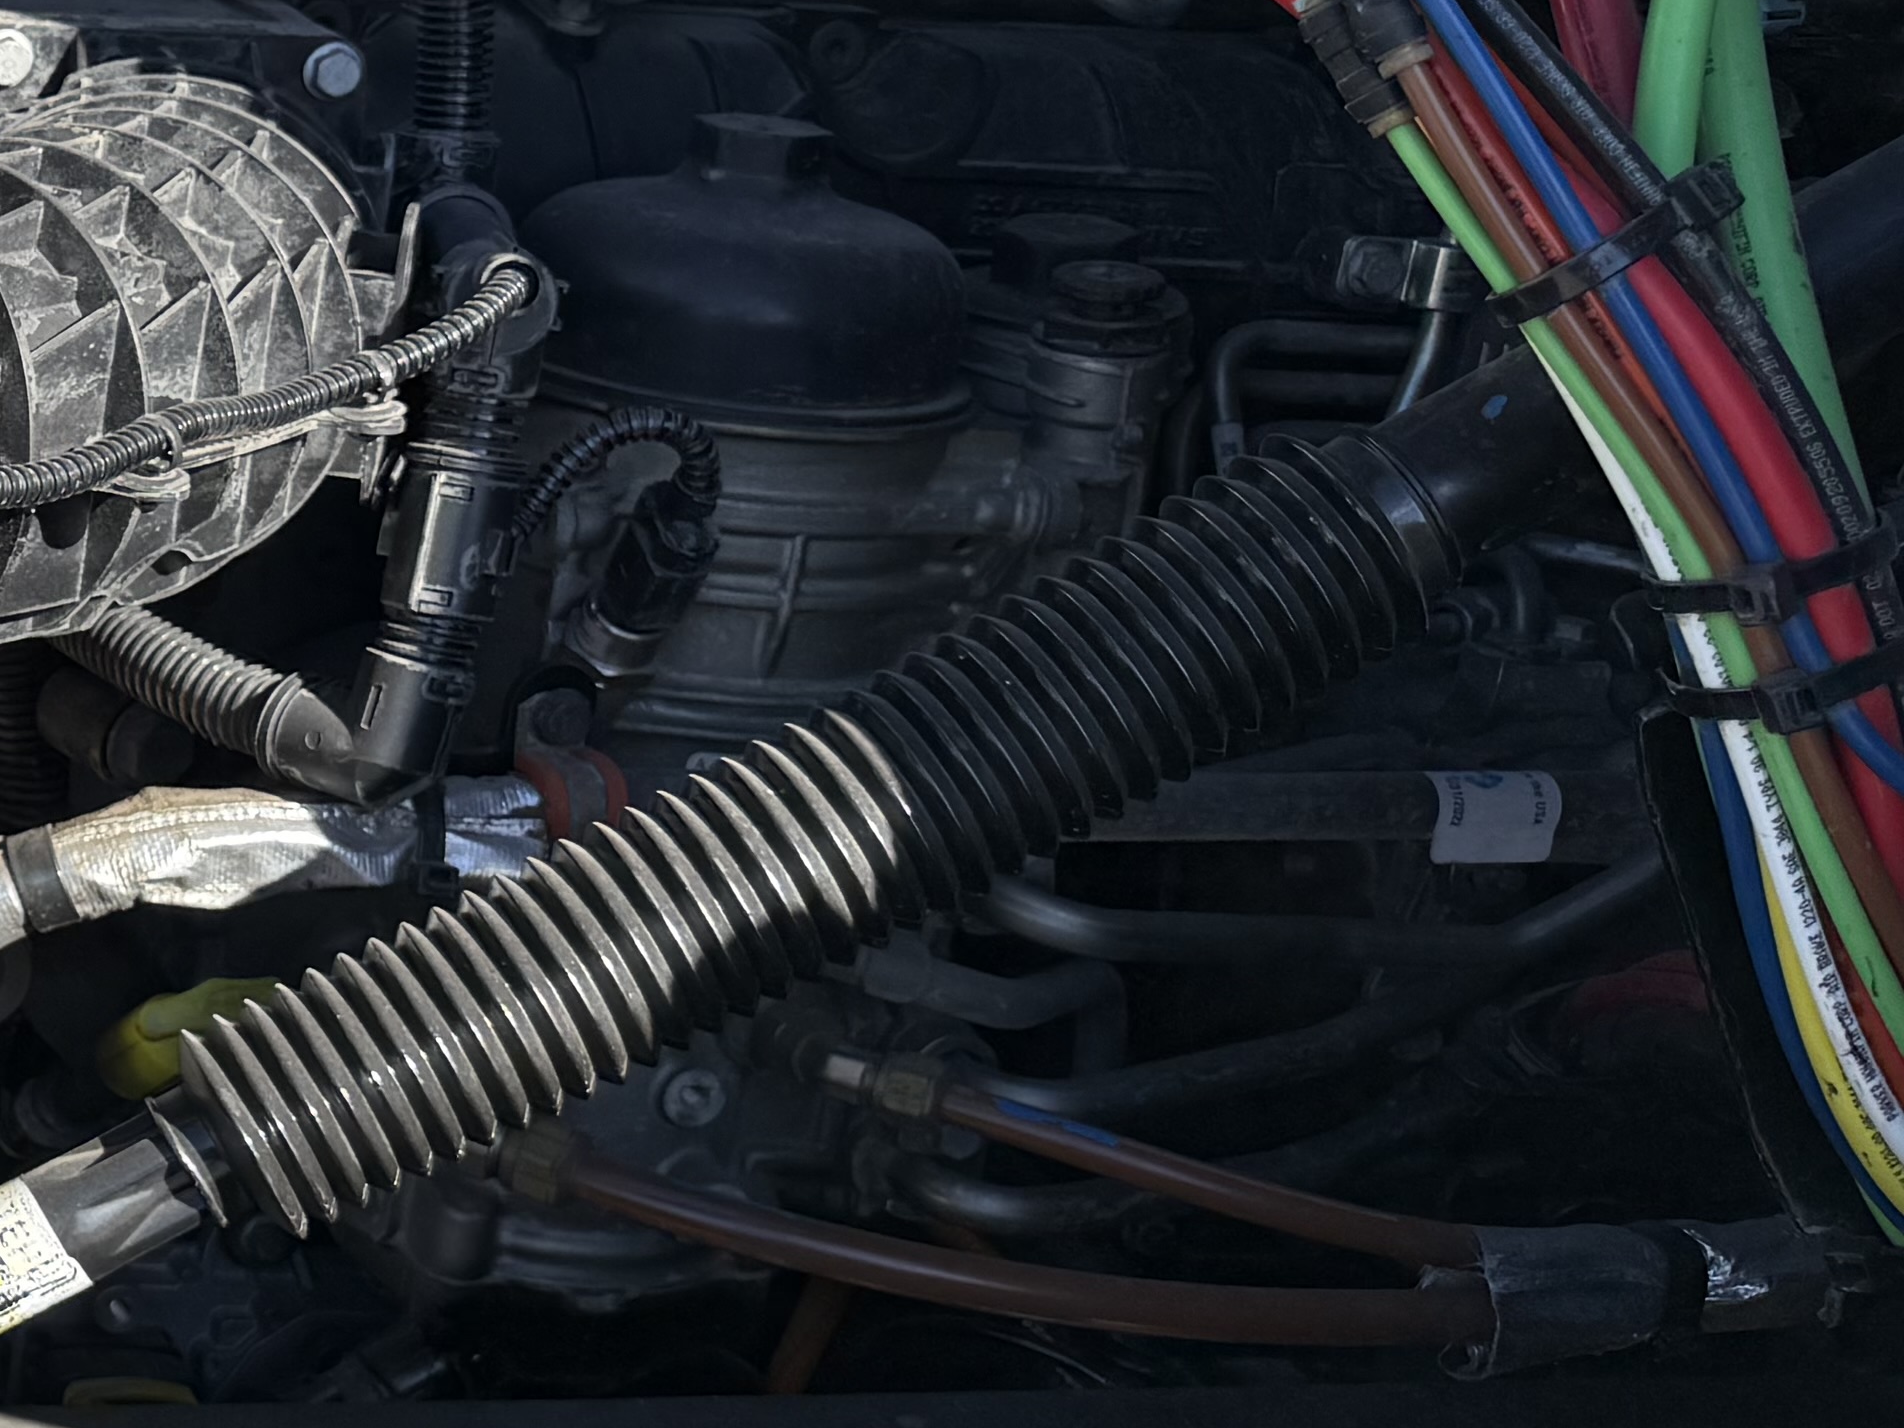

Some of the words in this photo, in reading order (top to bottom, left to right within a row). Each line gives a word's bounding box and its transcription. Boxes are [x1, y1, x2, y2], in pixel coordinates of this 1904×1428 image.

[1769, 371, 1817, 442] EXTRUDED
[1534, 801, 1546, 825] USA
[1754, 777, 1782, 813] TYPE
